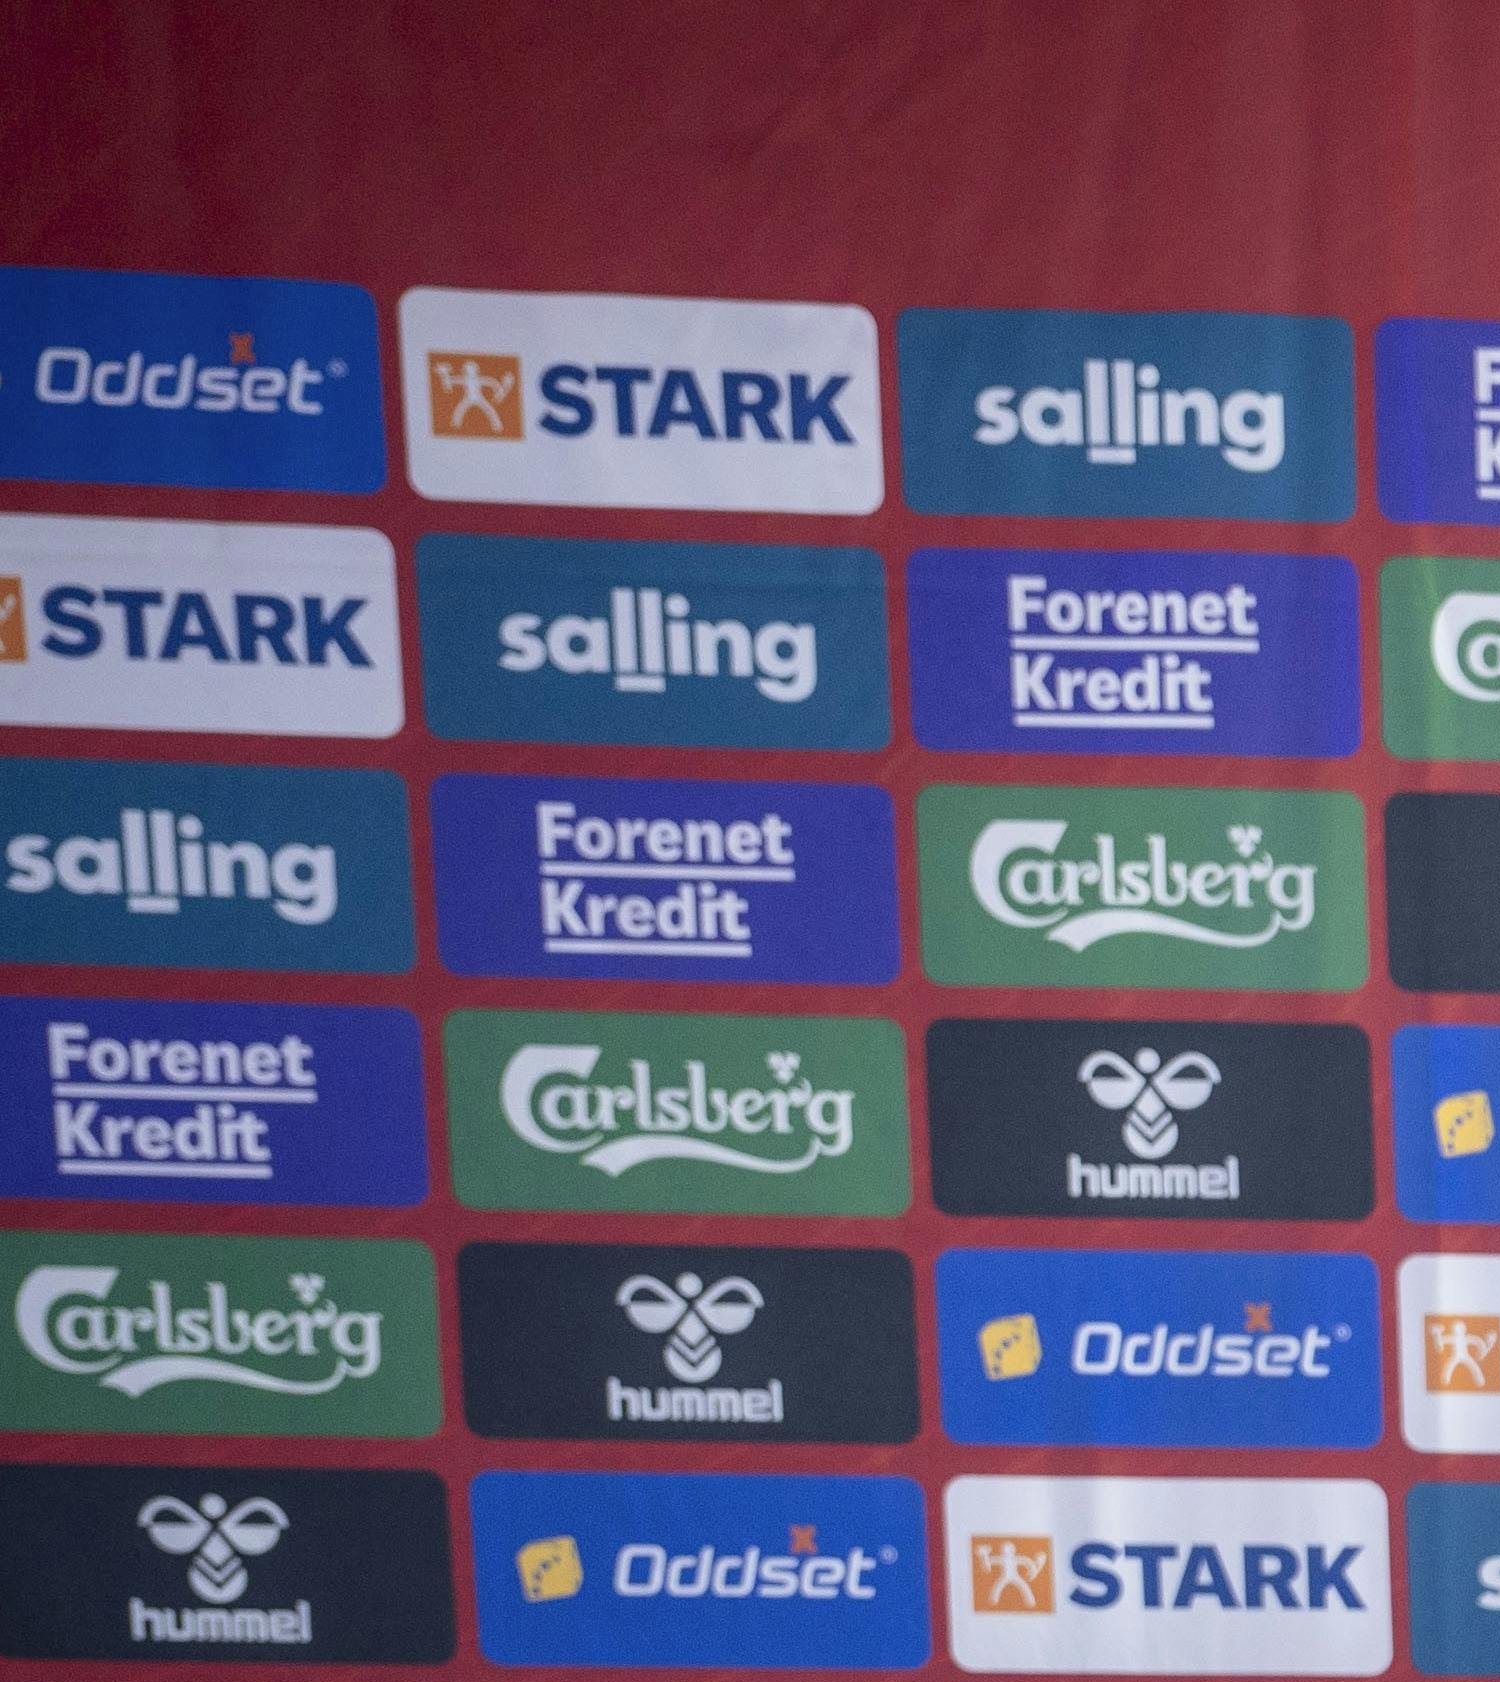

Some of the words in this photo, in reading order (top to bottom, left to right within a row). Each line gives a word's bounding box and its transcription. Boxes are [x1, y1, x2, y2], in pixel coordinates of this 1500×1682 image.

[538, 362, 854, 445] STARK
[976, 359, 1286, 473] salling
[40, 584, 372, 668] STARK
[1009, 576, 1258, 636] Forenet
[500, 588, 818, 703] salling
[1012, 654, 1213, 712] Kredit
[538, 803, 794, 865] Forenet
[6, 809, 338, 925] salling
[969, 819, 1316, 952] Carlsberg
[542, 880, 751, 941] Kredit
[49, 1024, 315, 1086] Forenet
[55, 1102, 270, 1162] Kredit
[501, 1044, 855, 1176] Carlsberg
[1067, 1153, 1240, 1200] hummel
[15, 1265, 382, 1397] Carlsberg
[606, 1377, 784, 1423] hummel
[129, 1598, 312, 1644] hummel
